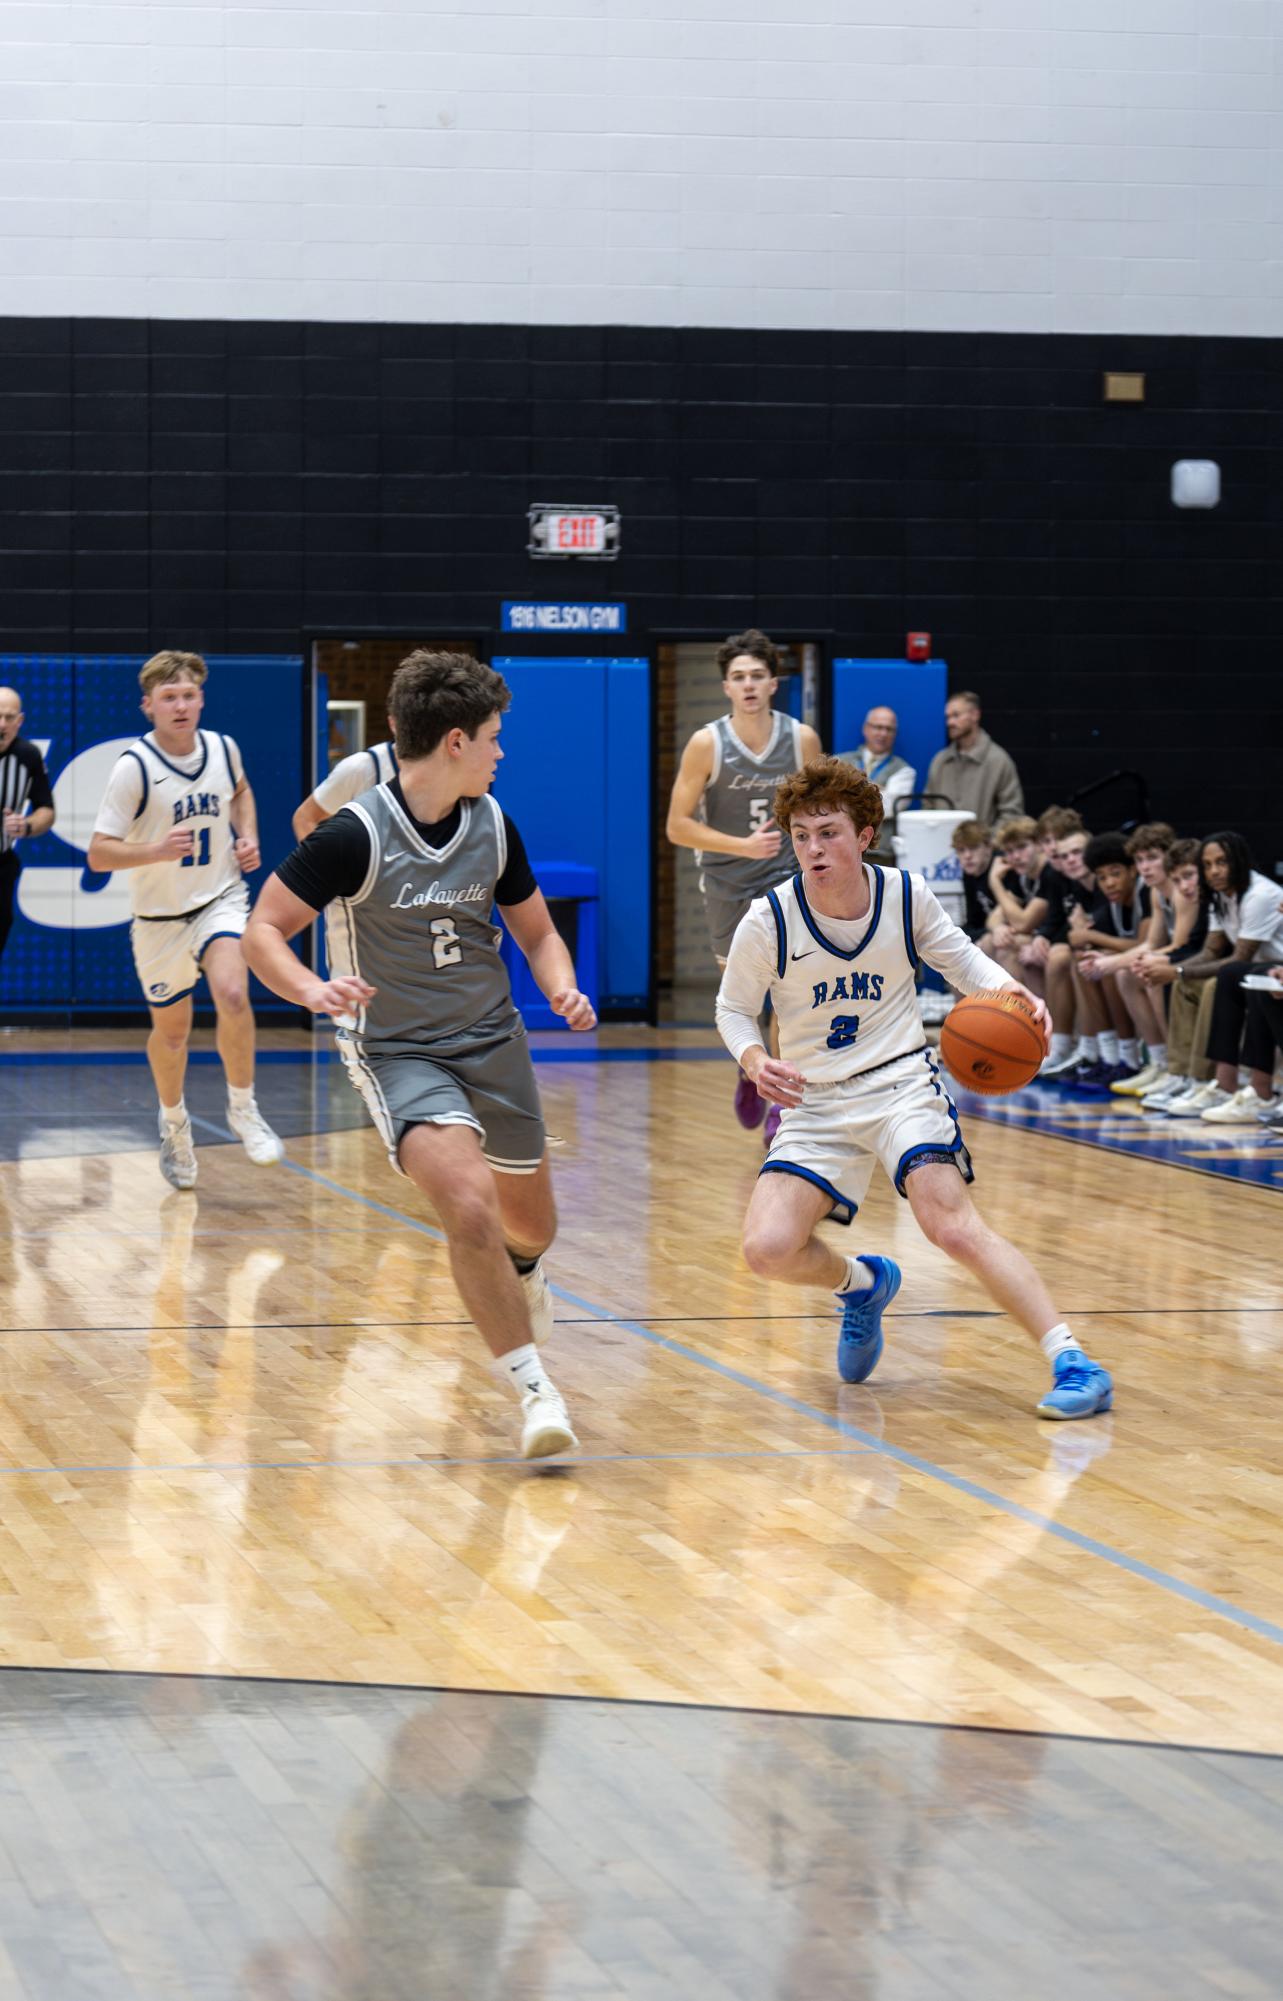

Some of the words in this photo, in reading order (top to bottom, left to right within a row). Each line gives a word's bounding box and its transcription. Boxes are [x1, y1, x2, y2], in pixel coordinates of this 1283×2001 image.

[558, 517, 597, 548] EXIT
[536, 606, 589, 629] NELSON
[590, 606, 620, 629] GYM
[173, 792, 220, 825] RAMS
[748, 798, 769, 831] 5
[180, 827, 211, 867] 11
[390, 880, 488, 909] Lafayette
[429, 916, 464, 970] 2
[812, 971, 884, 1010] RAMS
[826, 1014, 859, 1050] 2
